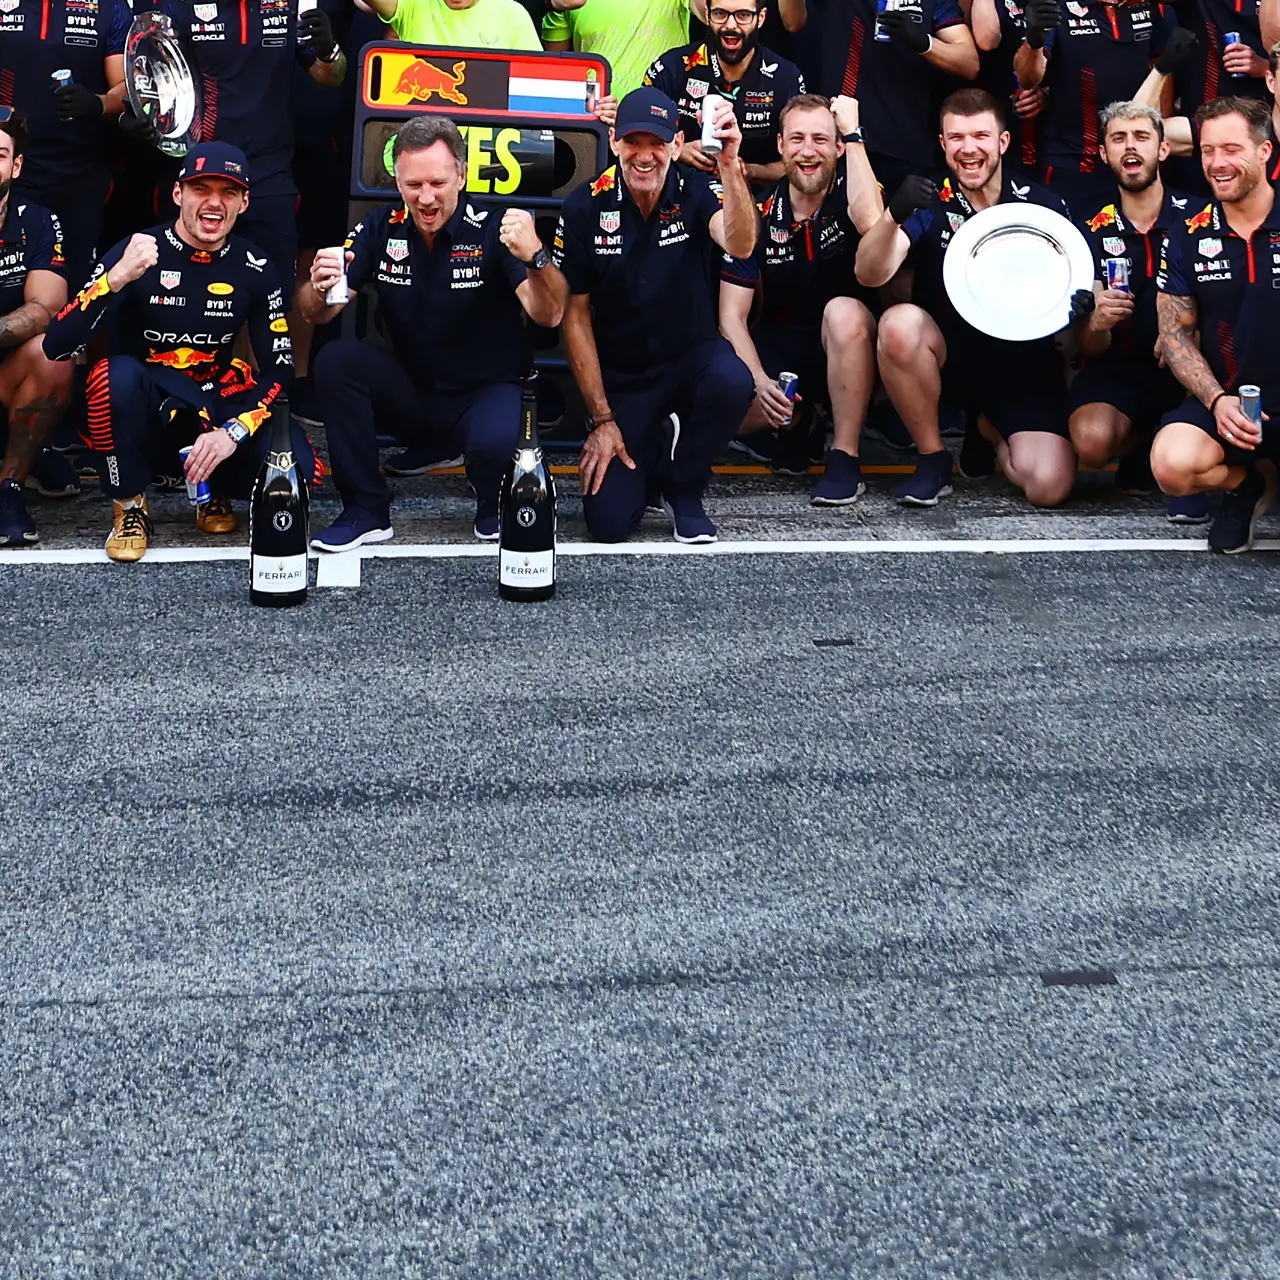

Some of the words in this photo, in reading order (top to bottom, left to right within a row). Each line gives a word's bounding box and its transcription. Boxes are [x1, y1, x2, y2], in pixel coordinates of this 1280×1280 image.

[67, 16, 96, 26] BYBIT
[263, 16, 288, 26] BYBIT
[65, 27, 98, 35] HONDA
[191, 24, 216, 32] Mobil
[711, 54, 720, 78] zoom
[678, 99, 700, 110] Mobil
[746, 111, 771, 121] BYBIT
[195, 157, 206, 171] 1
[956, 192, 972, 214] zoom
[600, 211, 620, 221] TAG
[164, 228, 184, 252] zoom
[388, 239, 408, 248] TAG
[659, 233, 689, 247] HONDA
[379, 261, 403, 274] Mobil
[1194, 261, 1221, 272] Mobil
[453, 267, 479, 279] BYBIT
[1197, 272, 1232, 282] ORACLE
[378, 274, 411, 285] ORACLE
[451, 280, 484, 289] HONDA
[150, 295, 175, 306] Mobil
[206, 299, 232, 310] BYBIT
[143, 329, 233, 344] ORACLE
[279, 515, 286, 526] 1
[523, 511, 530, 523] 1
[258, 571, 302, 581] FERRARI
[505, 565, 548, 576] FERRARI
